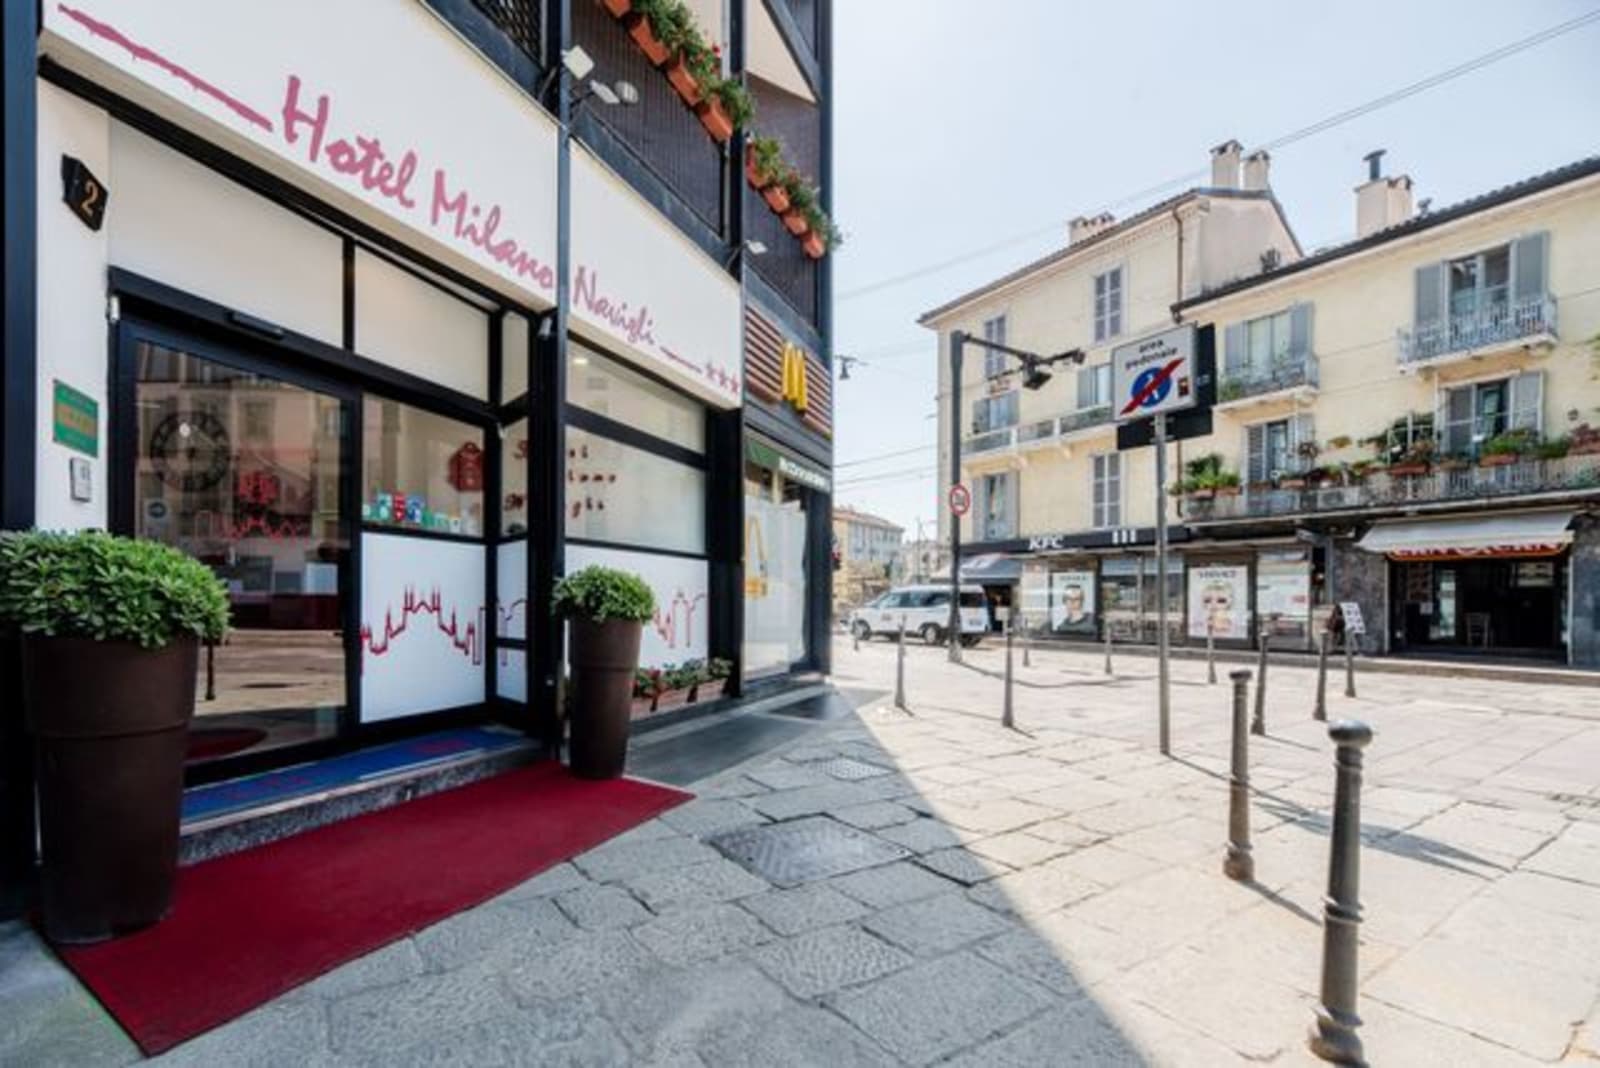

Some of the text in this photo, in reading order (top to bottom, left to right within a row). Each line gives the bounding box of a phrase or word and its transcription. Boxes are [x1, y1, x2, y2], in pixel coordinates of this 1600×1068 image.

[81, 181, 98, 217] 2
[282, 74, 655, 345] Hotel Milano Navigli
[1027, 535, 1065, 550] KFC
